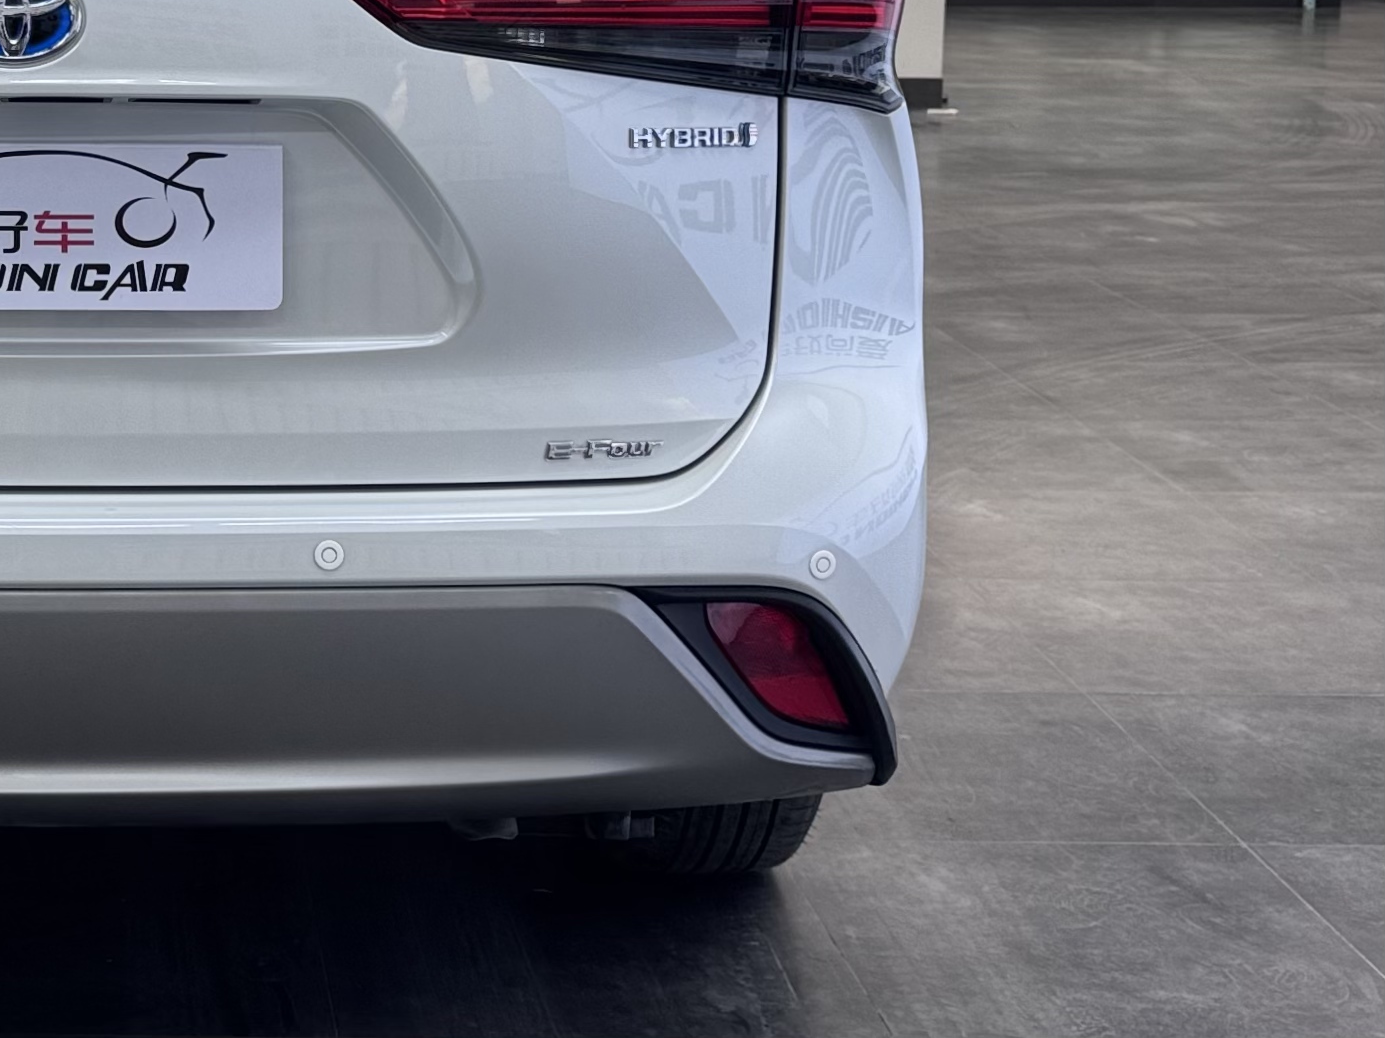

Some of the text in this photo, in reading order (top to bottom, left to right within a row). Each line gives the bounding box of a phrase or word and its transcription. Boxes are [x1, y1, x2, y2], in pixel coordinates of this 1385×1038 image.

[628, 126, 740, 149] HYBRID
[70, 259, 190, 301] CAR
[545, 438, 665, 462] E-Four
